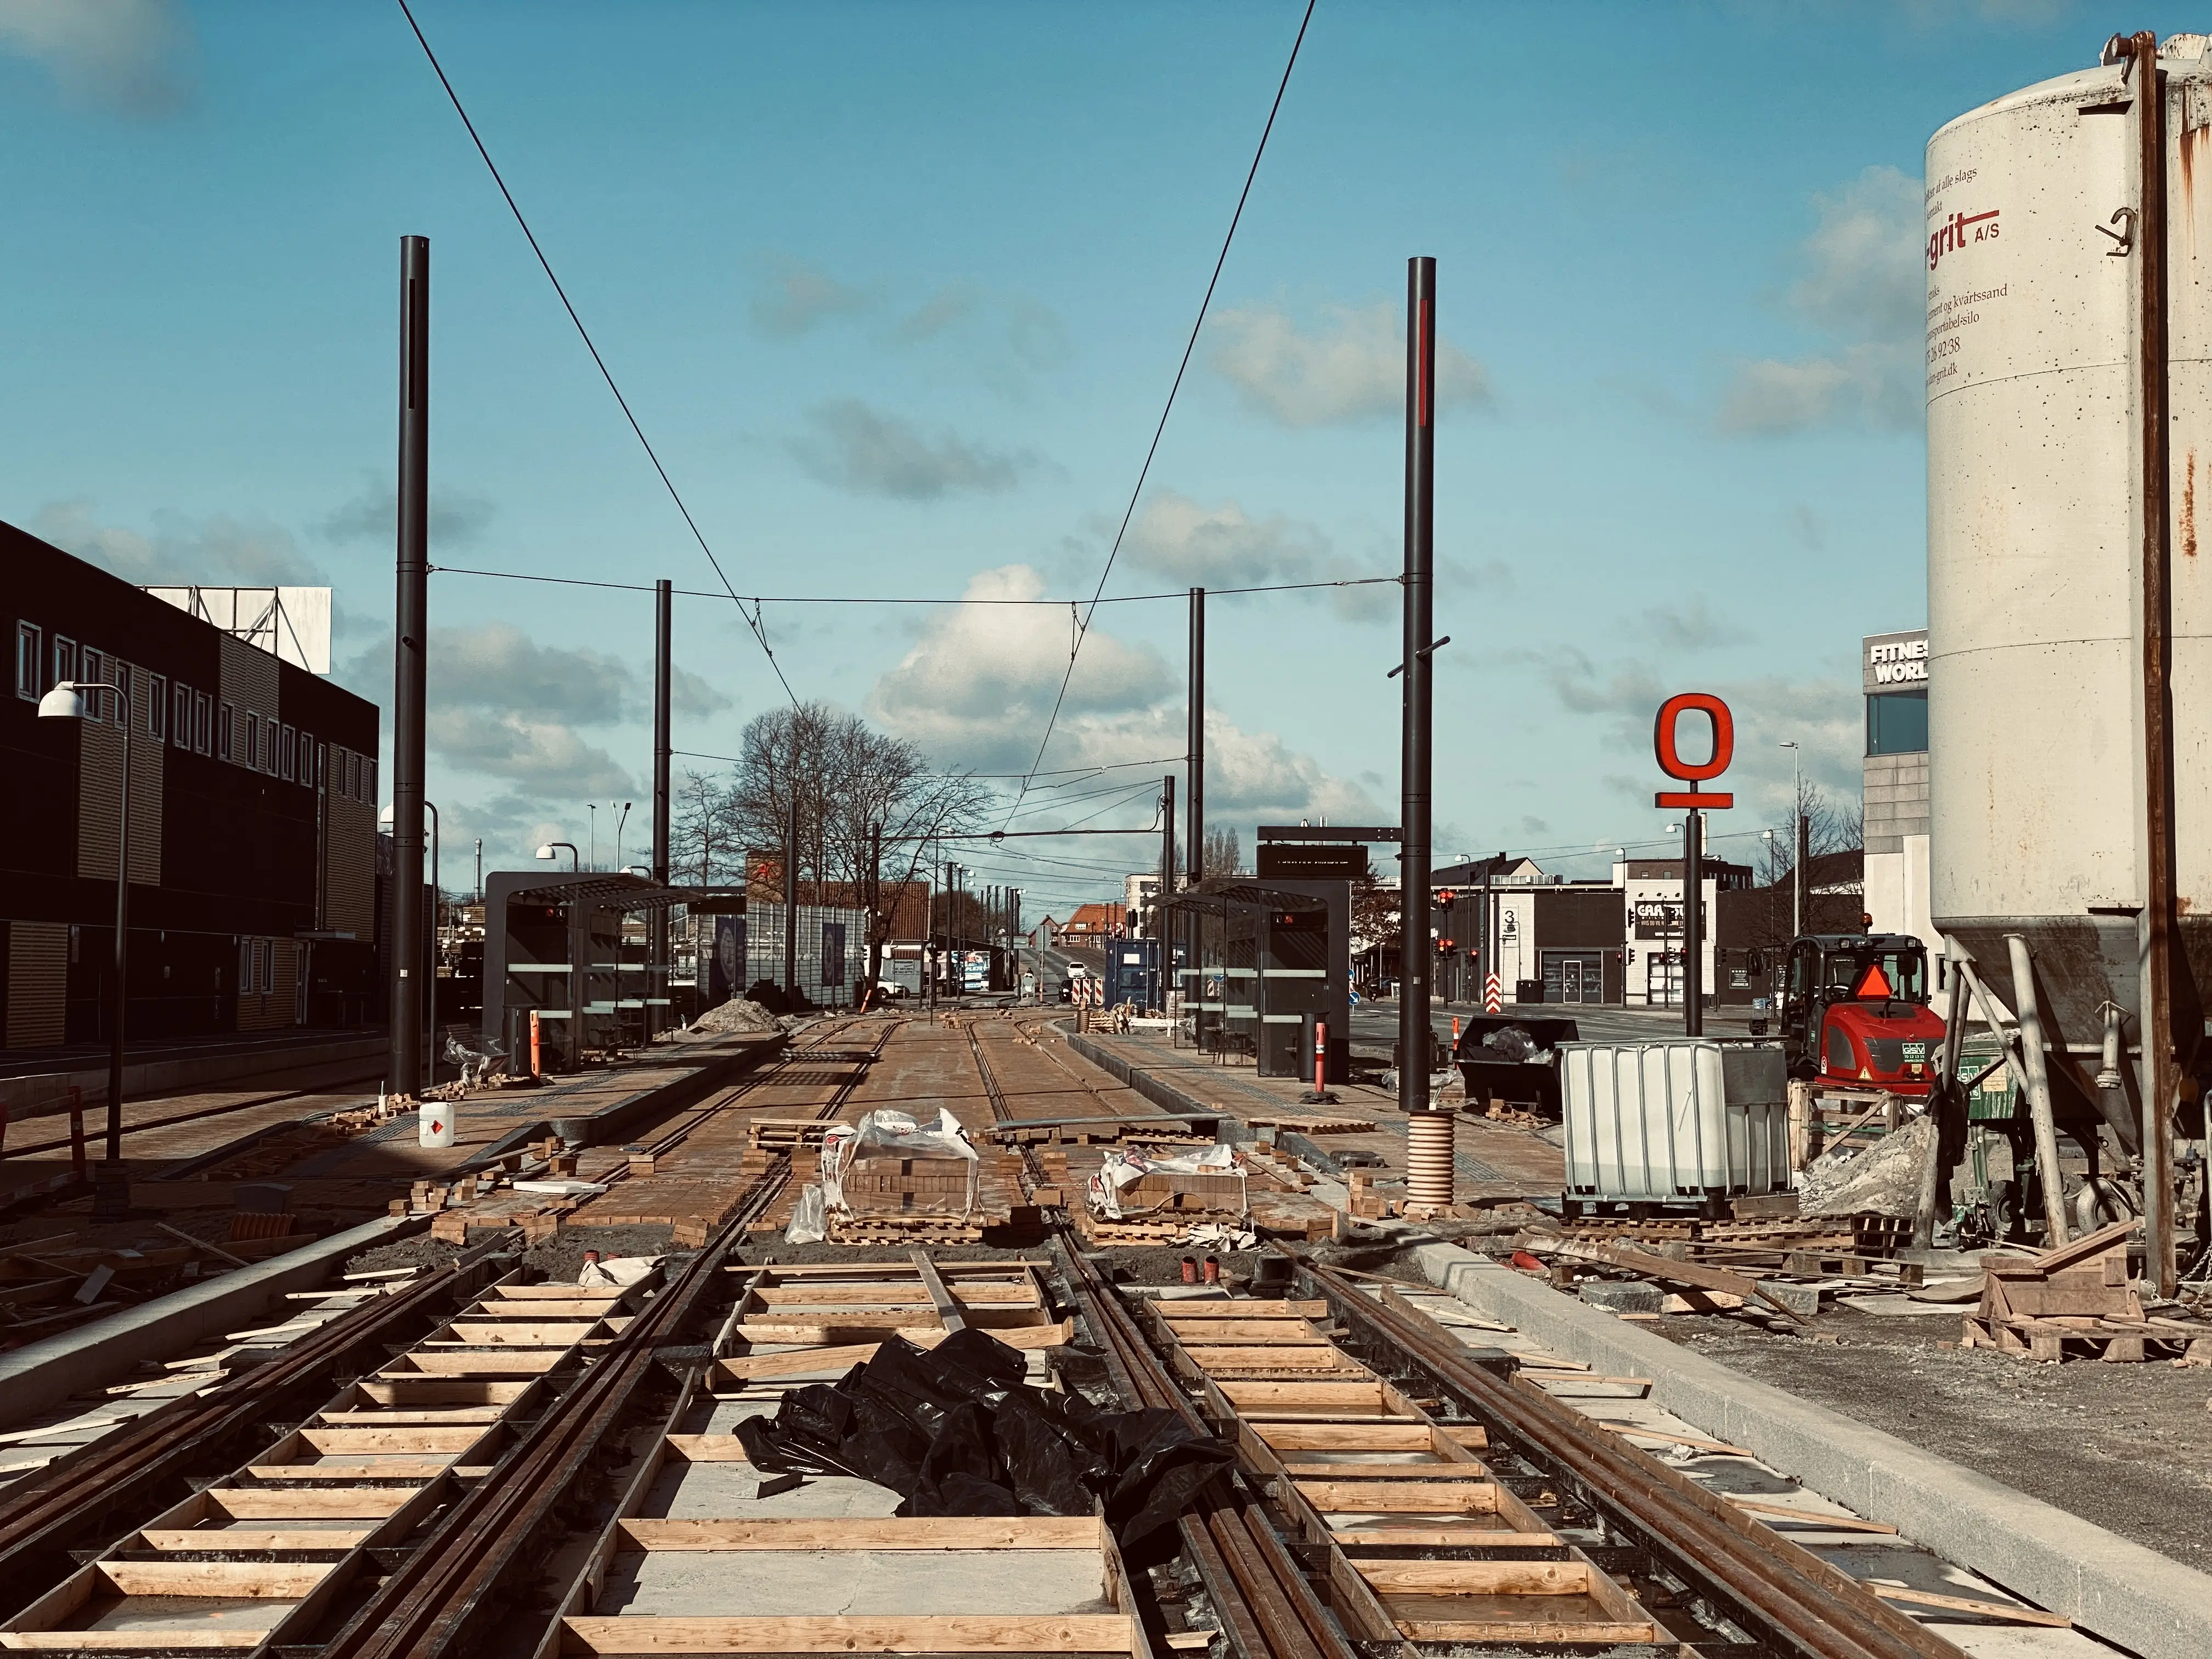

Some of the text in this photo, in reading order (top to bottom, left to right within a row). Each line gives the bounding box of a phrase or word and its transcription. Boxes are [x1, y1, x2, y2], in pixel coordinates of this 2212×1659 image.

[1936, 179, 1941, 194] af
[1942, 174, 1953, 190] alle
[1955, 168, 1977, 184] slags
[1975, 223, 2000, 243] A/S
[1944, 301, 1952, 314] og
[1953, 283, 2008, 308] kvartssand
[1938, 341, 1947, 359] 92
[1948, 336, 1961, 355] 38
[1875, 661, 1929, 683] WORL
[1504, 910, 1515, 924] 3
